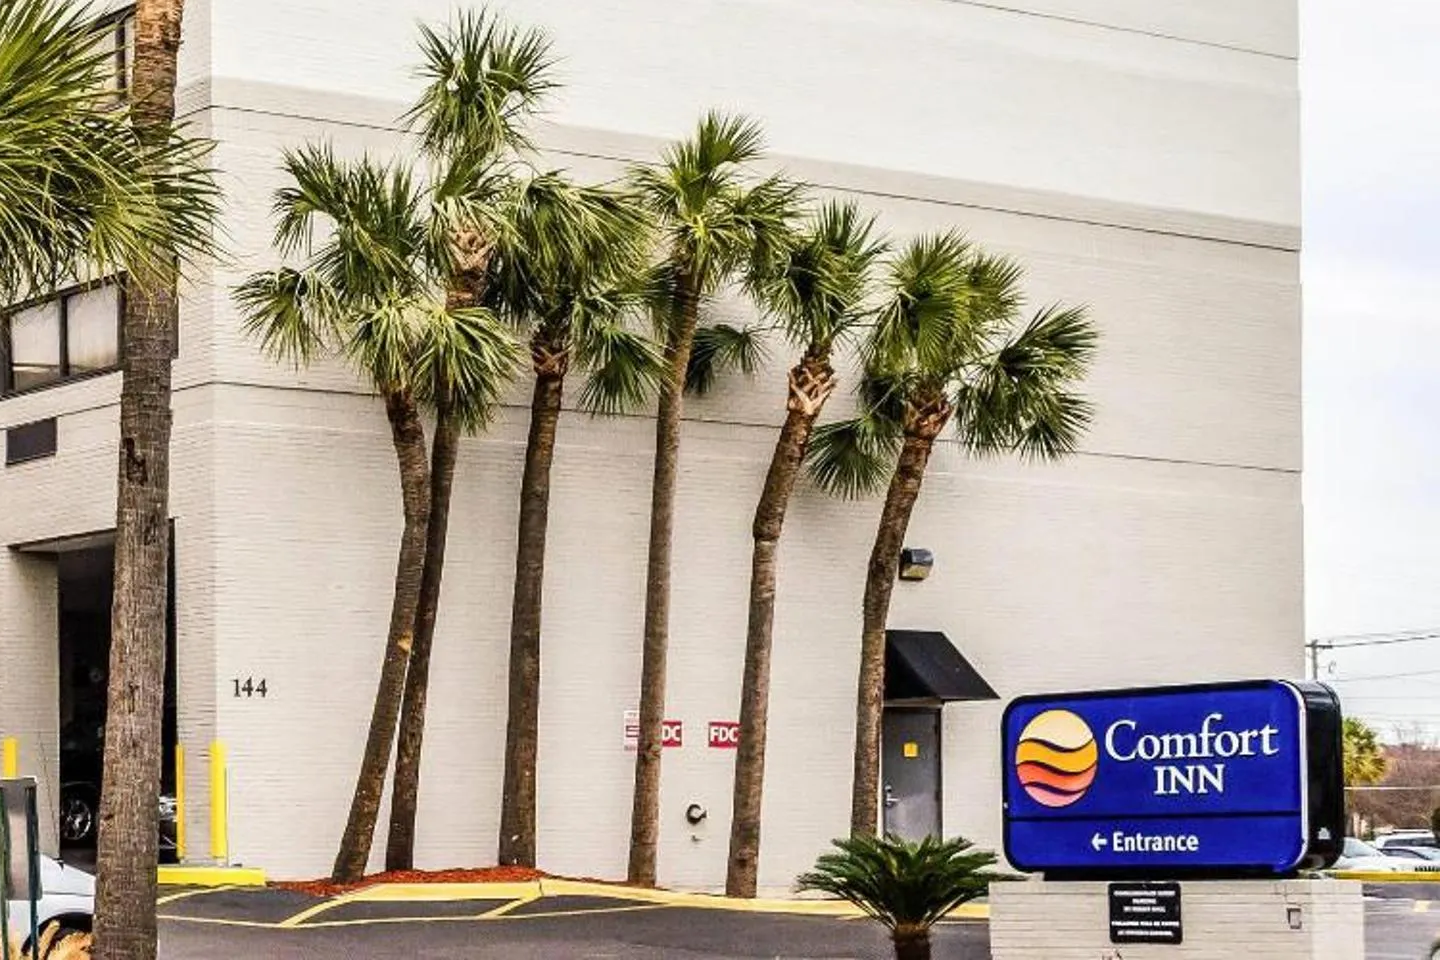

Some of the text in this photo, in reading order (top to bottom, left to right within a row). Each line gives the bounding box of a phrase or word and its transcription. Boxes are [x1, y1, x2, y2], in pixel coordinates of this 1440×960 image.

[231, 676, 268, 698] 144
[710, 726, 739, 742] FDC
[1105, 712, 1280, 761] Comfort
[1154, 764, 1225, 795] INN
[1112, 831, 1199, 852] Entrance
